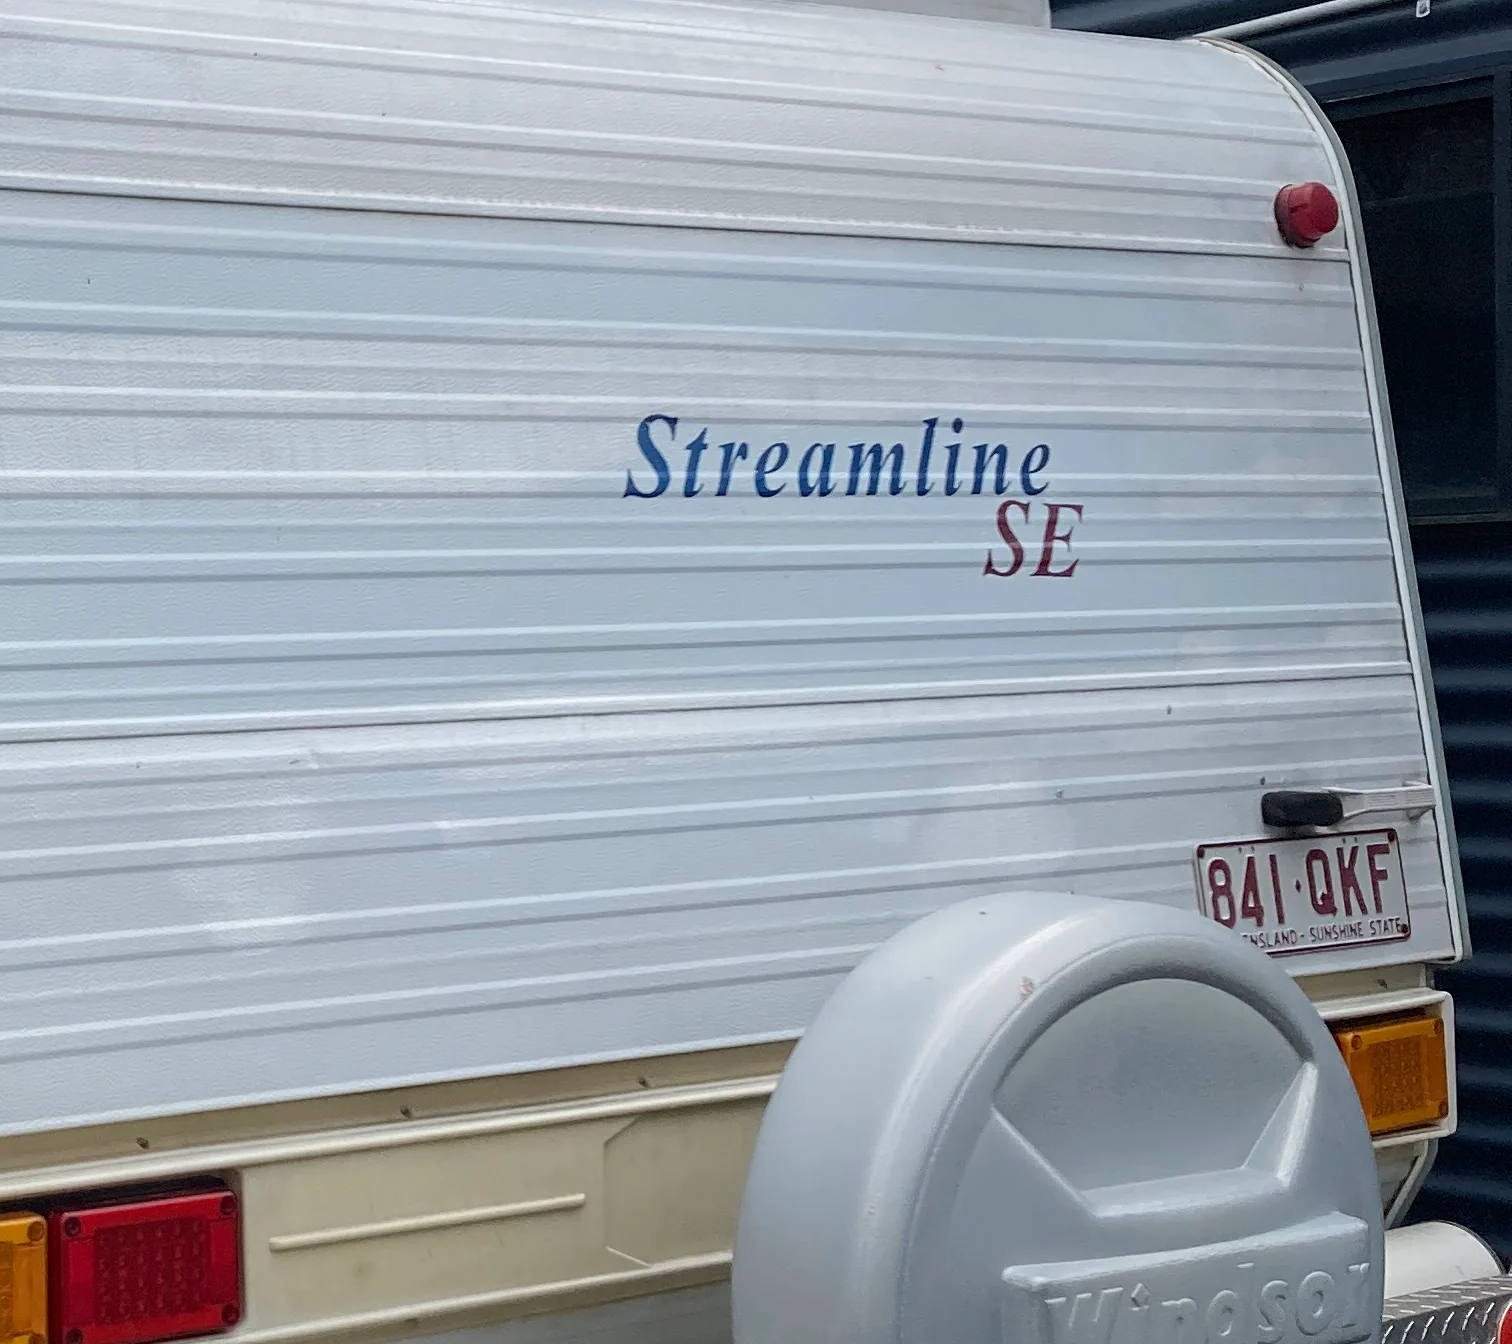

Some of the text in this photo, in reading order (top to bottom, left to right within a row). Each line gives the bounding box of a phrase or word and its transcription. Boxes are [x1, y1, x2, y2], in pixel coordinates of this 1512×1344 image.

[623, 413, 1051, 498] Streamline
[982, 499, 1085, 578] SE
[1309, 920, 1364, 943] SUNSHINE
[1369, 916, 1402, 937] STATE
